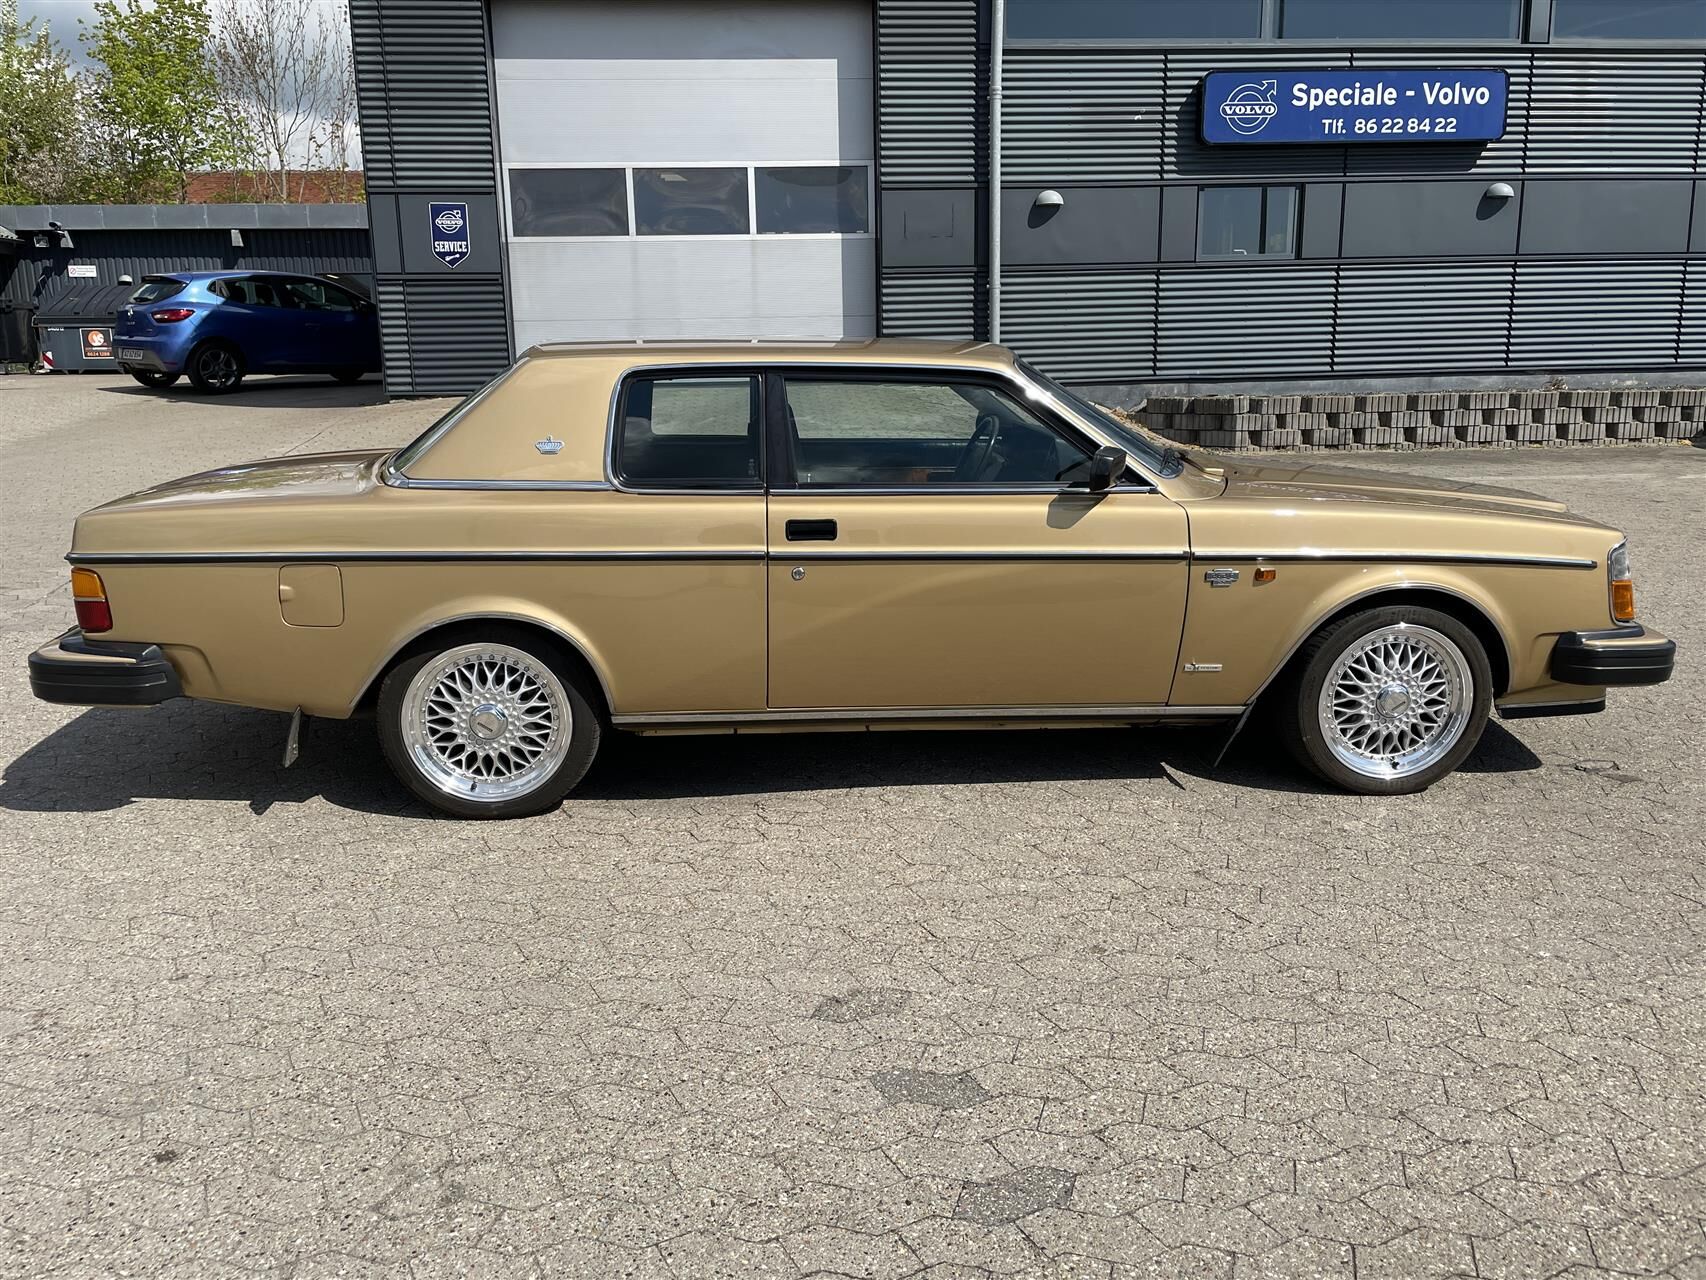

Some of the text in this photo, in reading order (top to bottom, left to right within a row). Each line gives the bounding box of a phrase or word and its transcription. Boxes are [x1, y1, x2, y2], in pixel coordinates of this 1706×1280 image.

[1291, 82, 1398, 111] Speciale
[1422, 81, 1490, 105] Volvo
[1223, 104, 1275, 115] VOLVO
[1321, 117, 1457, 134] Tlf. 86 22 84 22
[434, 241, 467, 252] SERVICE
